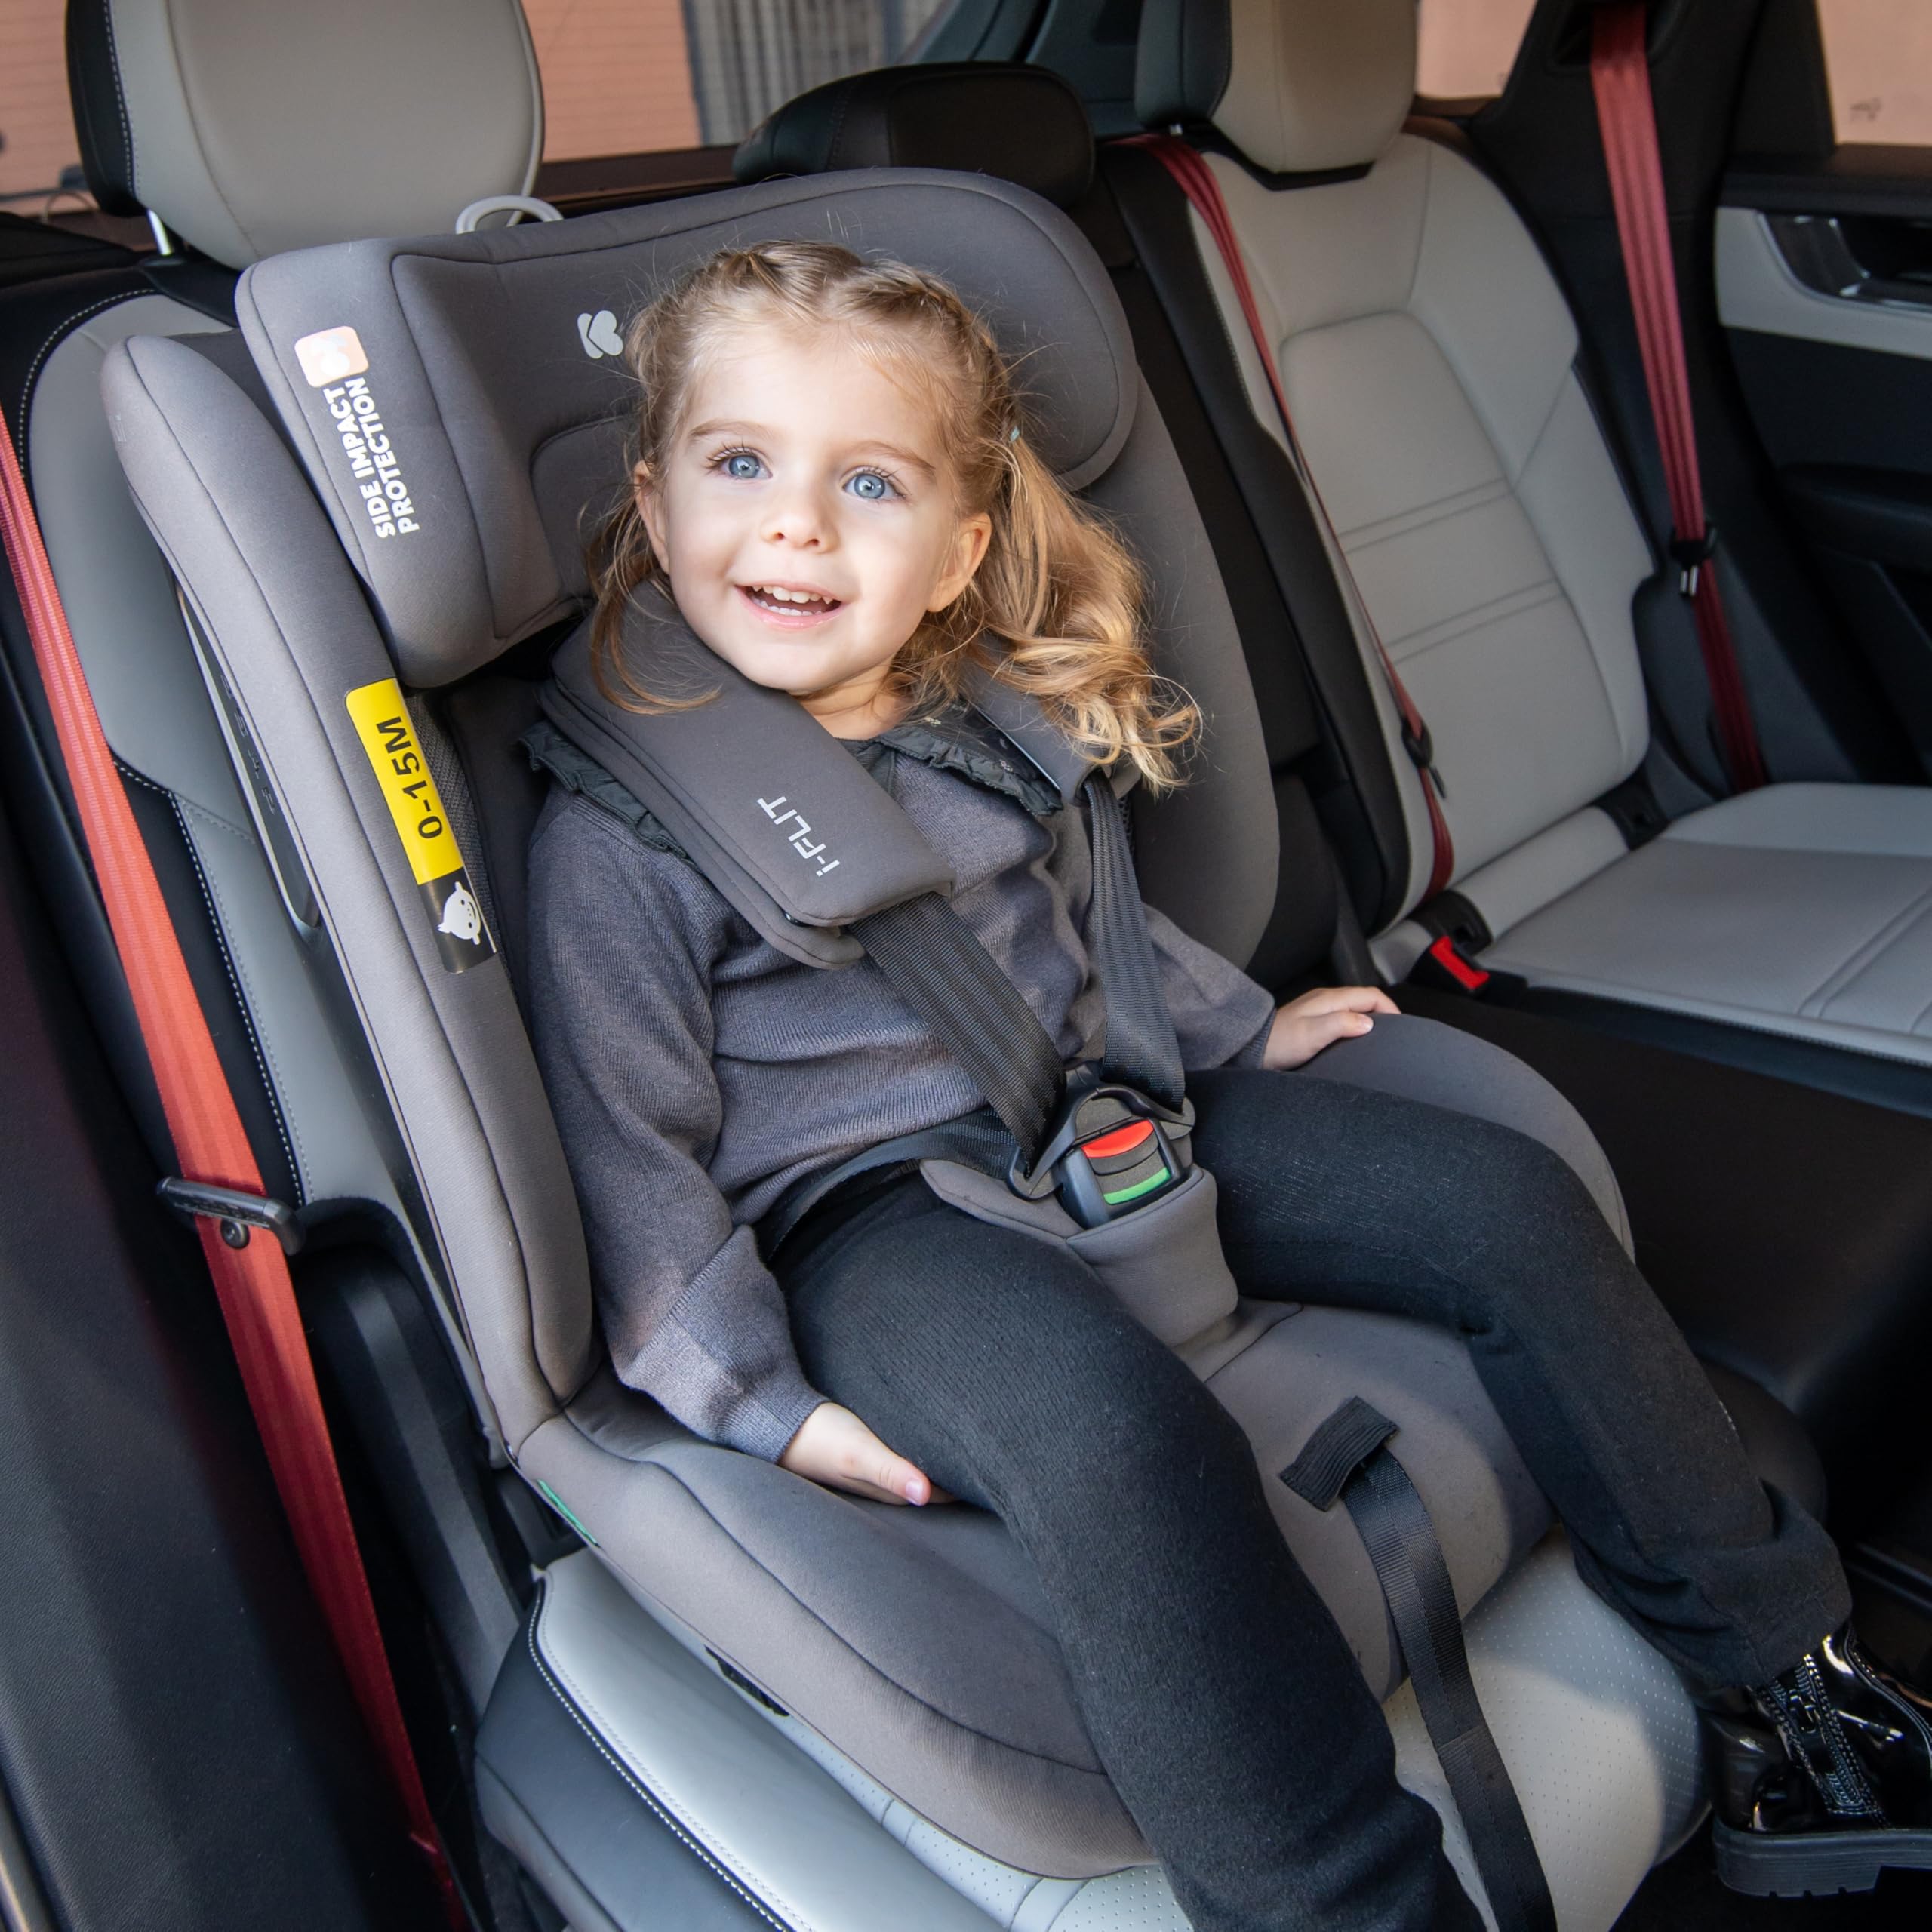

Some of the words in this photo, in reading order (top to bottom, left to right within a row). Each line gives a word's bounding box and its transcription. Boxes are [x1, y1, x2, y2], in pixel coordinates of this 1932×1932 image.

[323, 386, 374, 478] IMPACT
[345, 377, 420, 534] PROTECTION
[359, 480, 396, 538] SIDE
[376, 716, 443, 839] 0-15M
